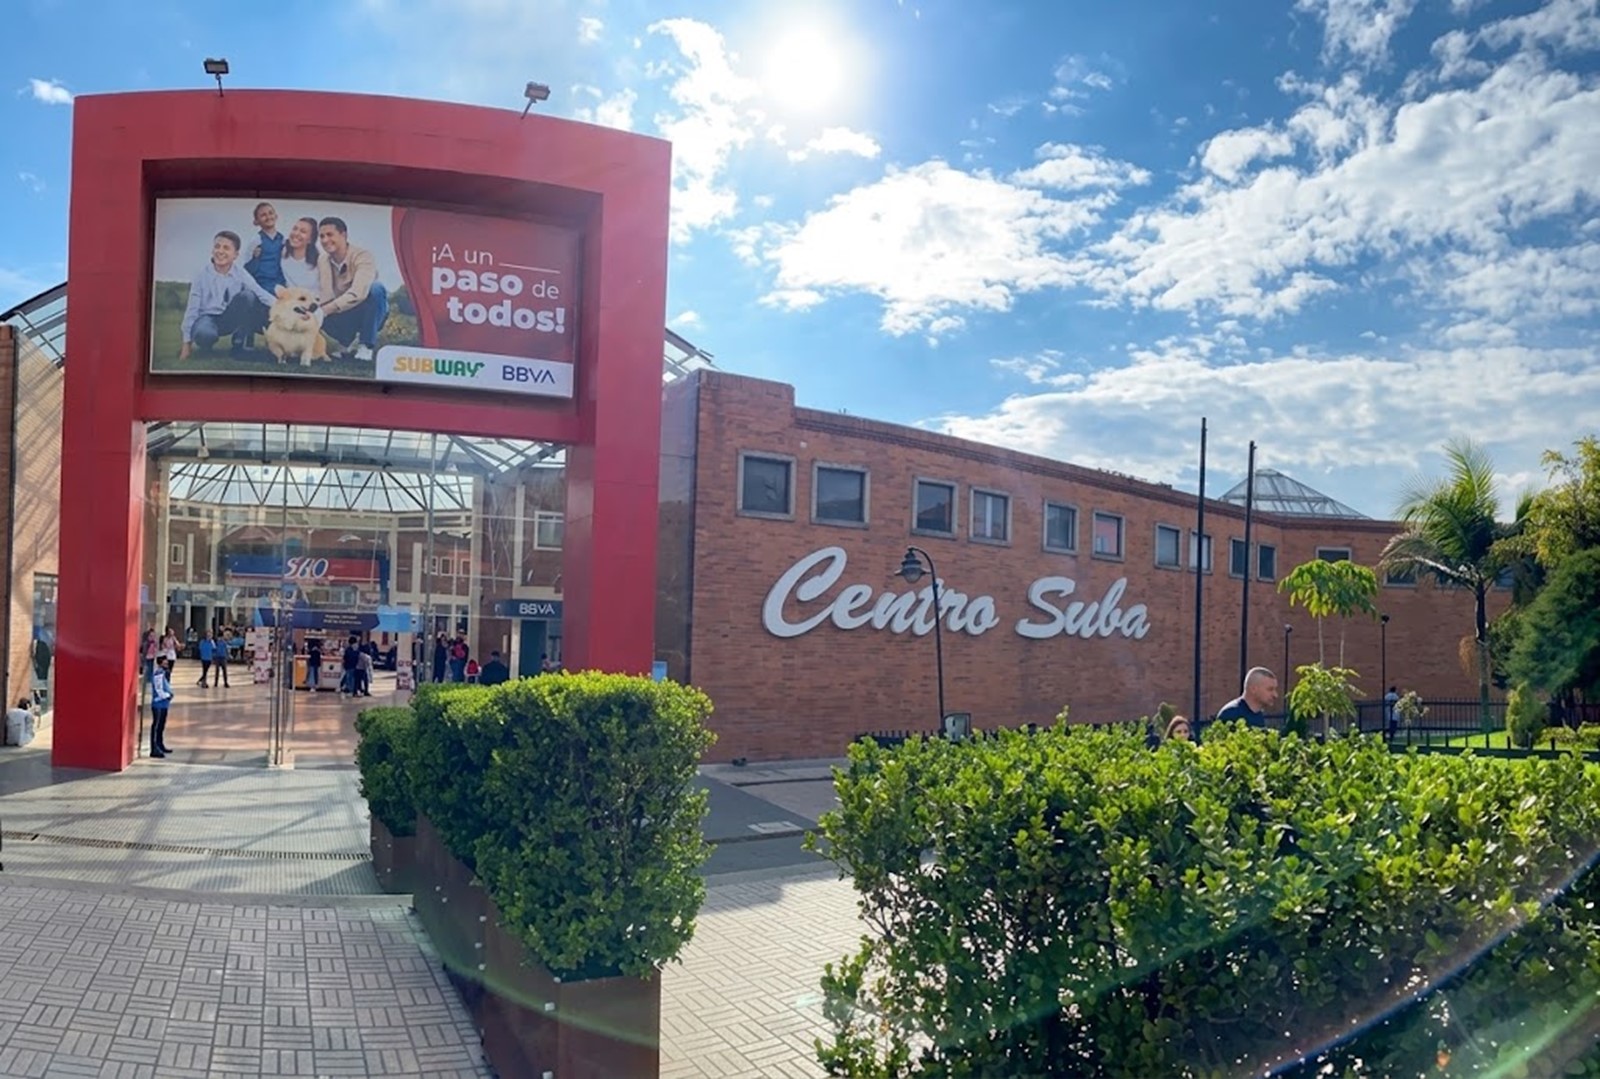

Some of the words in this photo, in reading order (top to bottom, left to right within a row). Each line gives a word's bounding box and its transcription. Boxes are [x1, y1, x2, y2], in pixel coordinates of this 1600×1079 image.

[432, 243, 455, 264] ¡A
[464, 250, 493, 266] un
[432, 266, 523, 296] paso
[532, 280, 560, 299] de
[446, 297, 565, 334] todos!
[393, 356, 485, 378] SUBWAY
[502, 365, 555, 384] BBVA
[763, 546, 999, 638] Centro
[1015, 576, 1151, 640] Suba
[519, 603, 555, 614] BBVA
